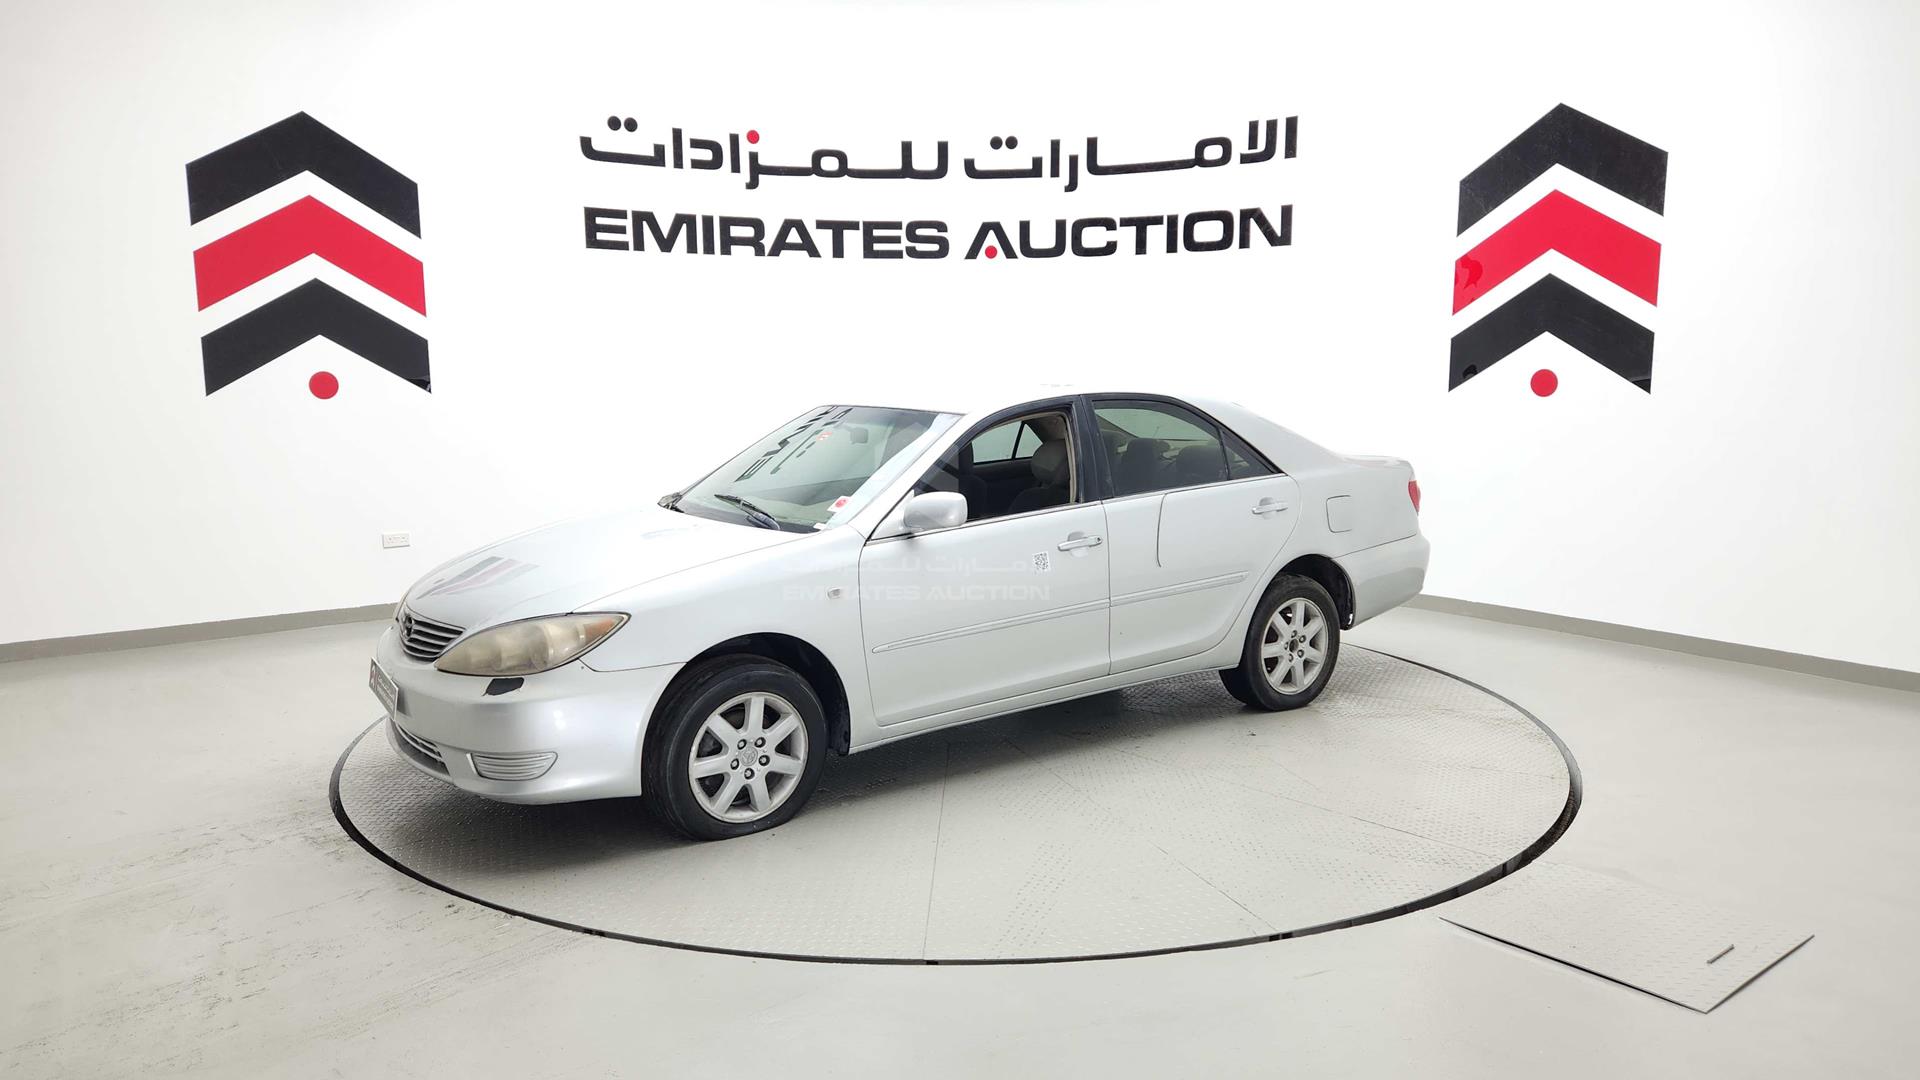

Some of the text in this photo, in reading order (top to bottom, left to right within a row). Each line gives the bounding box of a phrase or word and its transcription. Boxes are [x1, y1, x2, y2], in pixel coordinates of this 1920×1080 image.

[579, 115, 949, 190] للمزادات
[583, 204, 1293, 260] EMIRATES AUCTION
